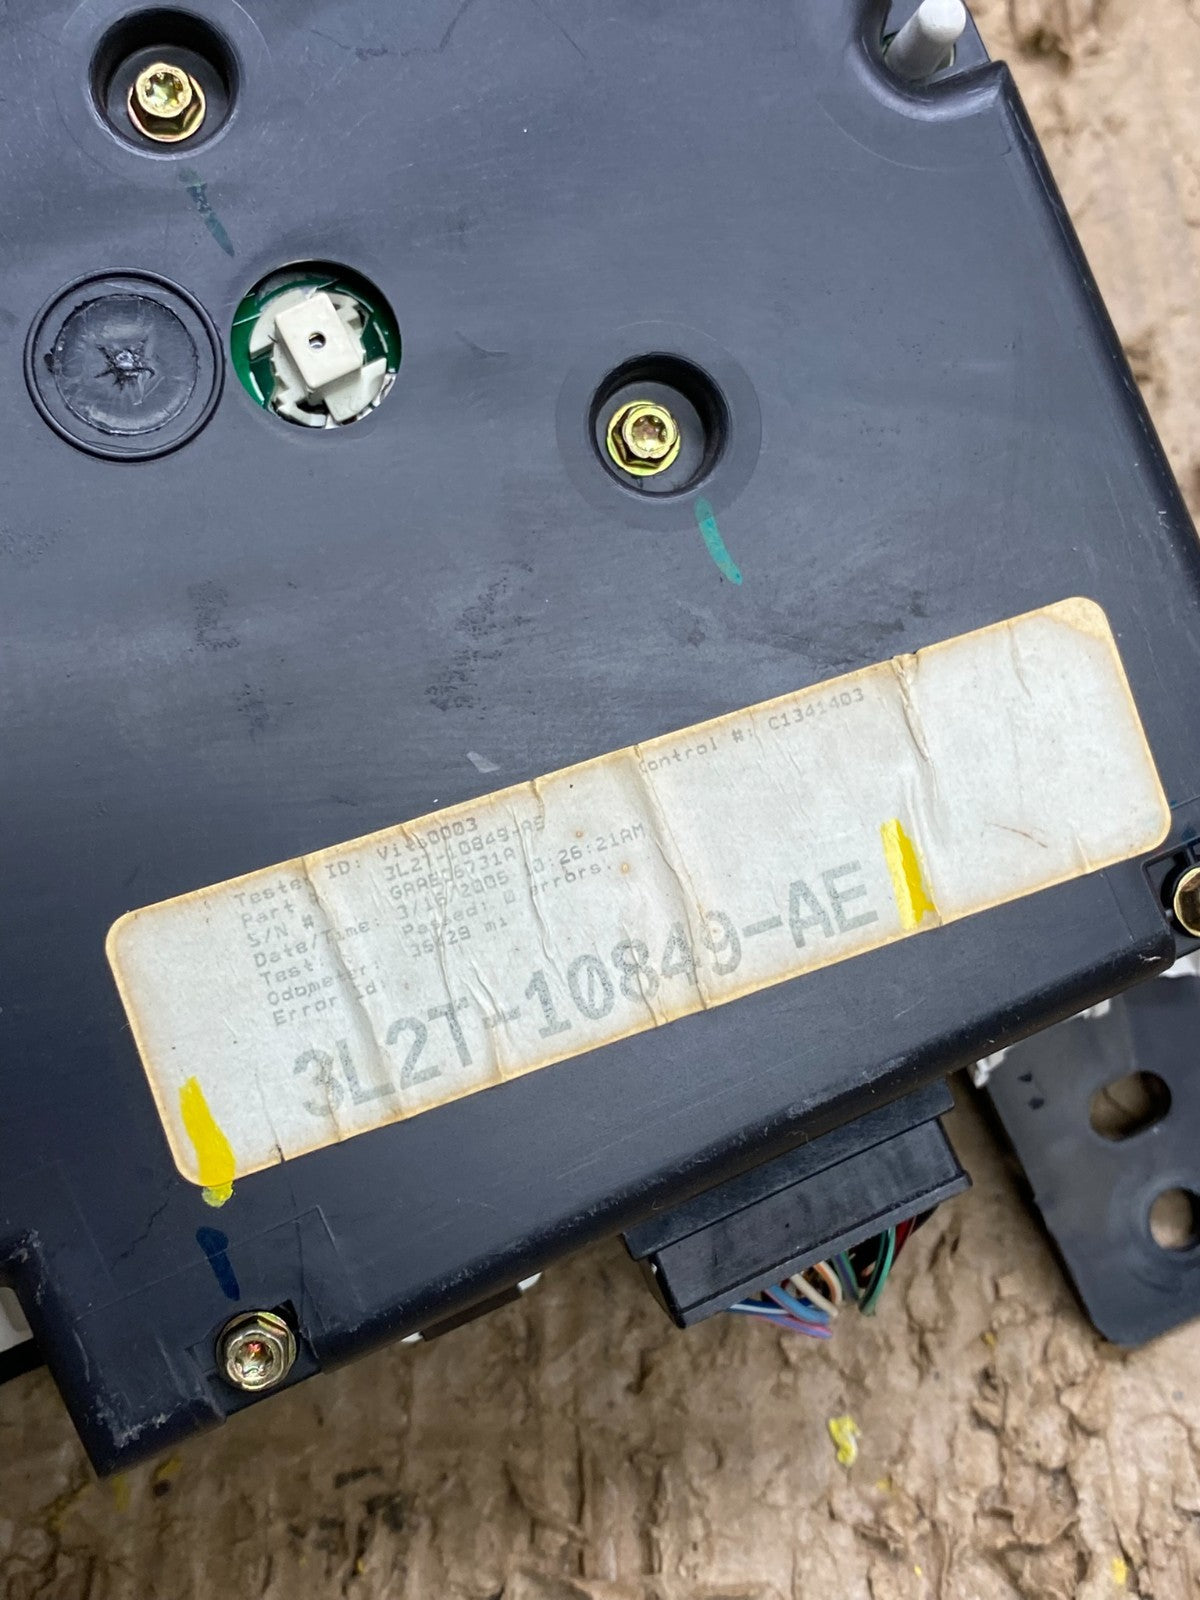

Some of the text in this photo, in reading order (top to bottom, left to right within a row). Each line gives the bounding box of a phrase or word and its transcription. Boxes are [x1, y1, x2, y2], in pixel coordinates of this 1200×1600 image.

[636, 735, 718, 774] Control
[730, 723, 754, 744] #:
[324, 855, 362, 880] ID:
[239, 897, 295, 928] Part
[246, 920, 289, 948] S/N
[258, 953, 325, 987] Test:
[530, 857, 612, 896] errors.
[252, 913, 381, 968] Date/Time:
[265, 958, 381, 1007] Odometer:
[482, 912, 508, 933] mi
[271, 993, 339, 1027] Error
[291, 861, 879, 1119] 3L2T-10849-AE
